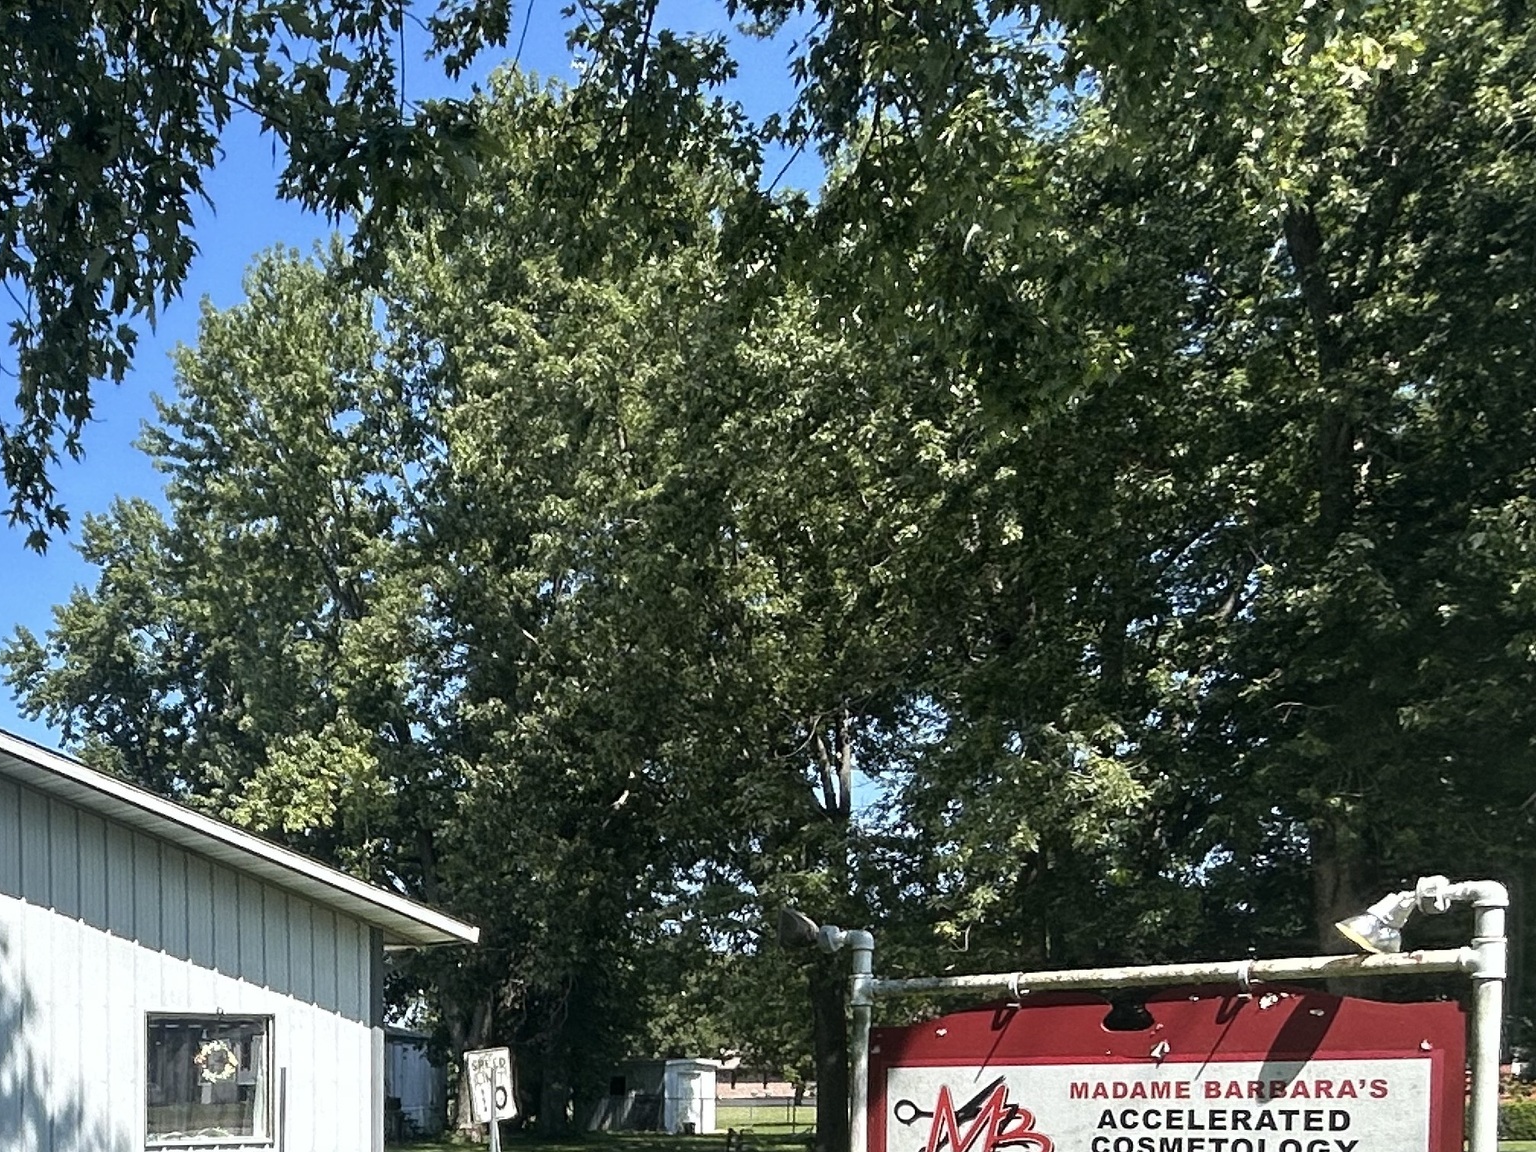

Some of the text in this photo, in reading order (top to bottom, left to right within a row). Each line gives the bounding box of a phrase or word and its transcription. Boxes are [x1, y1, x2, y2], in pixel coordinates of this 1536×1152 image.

[472, 1057, 506, 1071] SPEED
[1069, 1079, 1389, 1099] MADAME BARBARA'S
[1097, 1109, 1351, 1131] ACCELERATED
